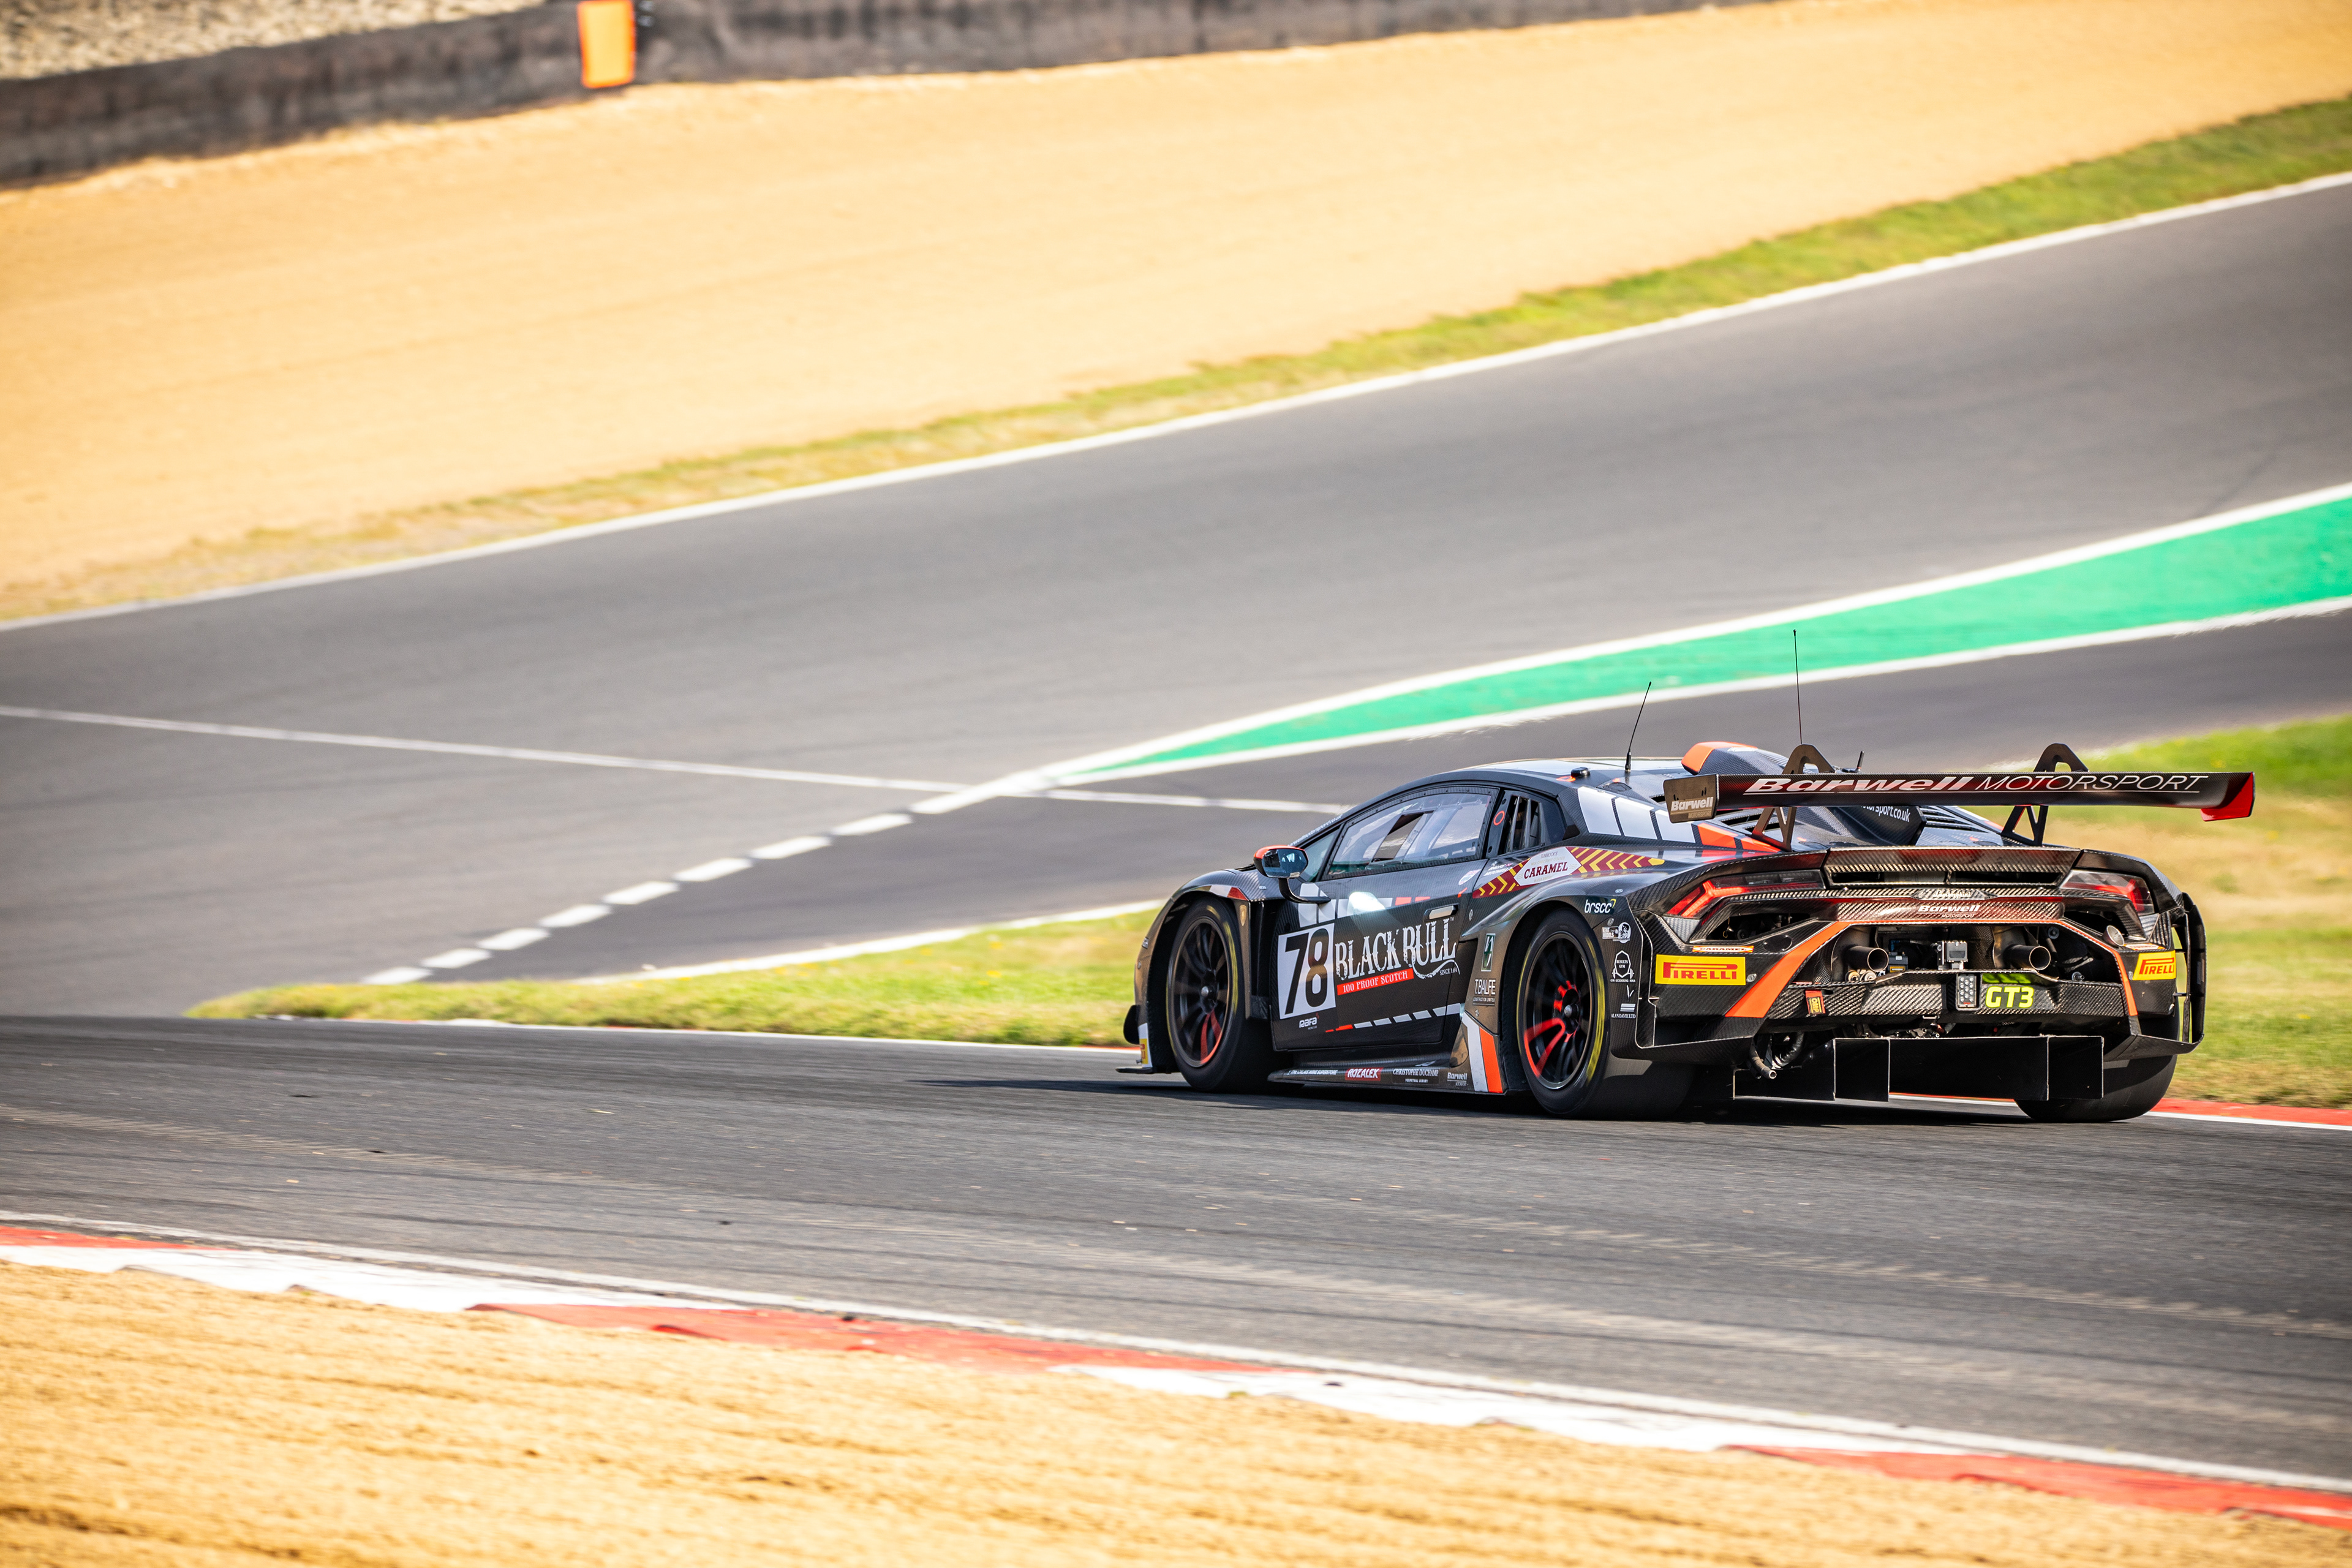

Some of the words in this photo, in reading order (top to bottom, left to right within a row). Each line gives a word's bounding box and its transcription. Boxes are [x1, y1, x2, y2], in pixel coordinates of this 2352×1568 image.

[1745, 777, 1974, 793] Barwell
[1975, 775, 2208, 791] MOTORSPORT
[1671, 797, 1714, 812] Barwell
[1688, 810, 1712, 819] MOTORSPORT
[1524, 862, 1568, 880] CARAMEL
[1584, 899, 1612, 913] brscc
[1335, 929, 1401, 980] BLACK
[1403, 918, 1457, 975] BULL
[1284, 928, 1329, 1015] 78
[1663, 962, 1738, 979] PIRELLI
[2139, 957, 2174, 974] PIRELLI
[1343, 984, 1355, 993] 100
[1356, 979, 1379, 990] PROOF
[1381, 971, 1409, 985] SCOTCH
[1475, 979, 1496, 995] T.BALFE
[1811, 998, 1820, 1012] OMP
[1985, 986, 2035, 1009] GT3
[1348, 1068, 1379, 1079] ROZALEX
